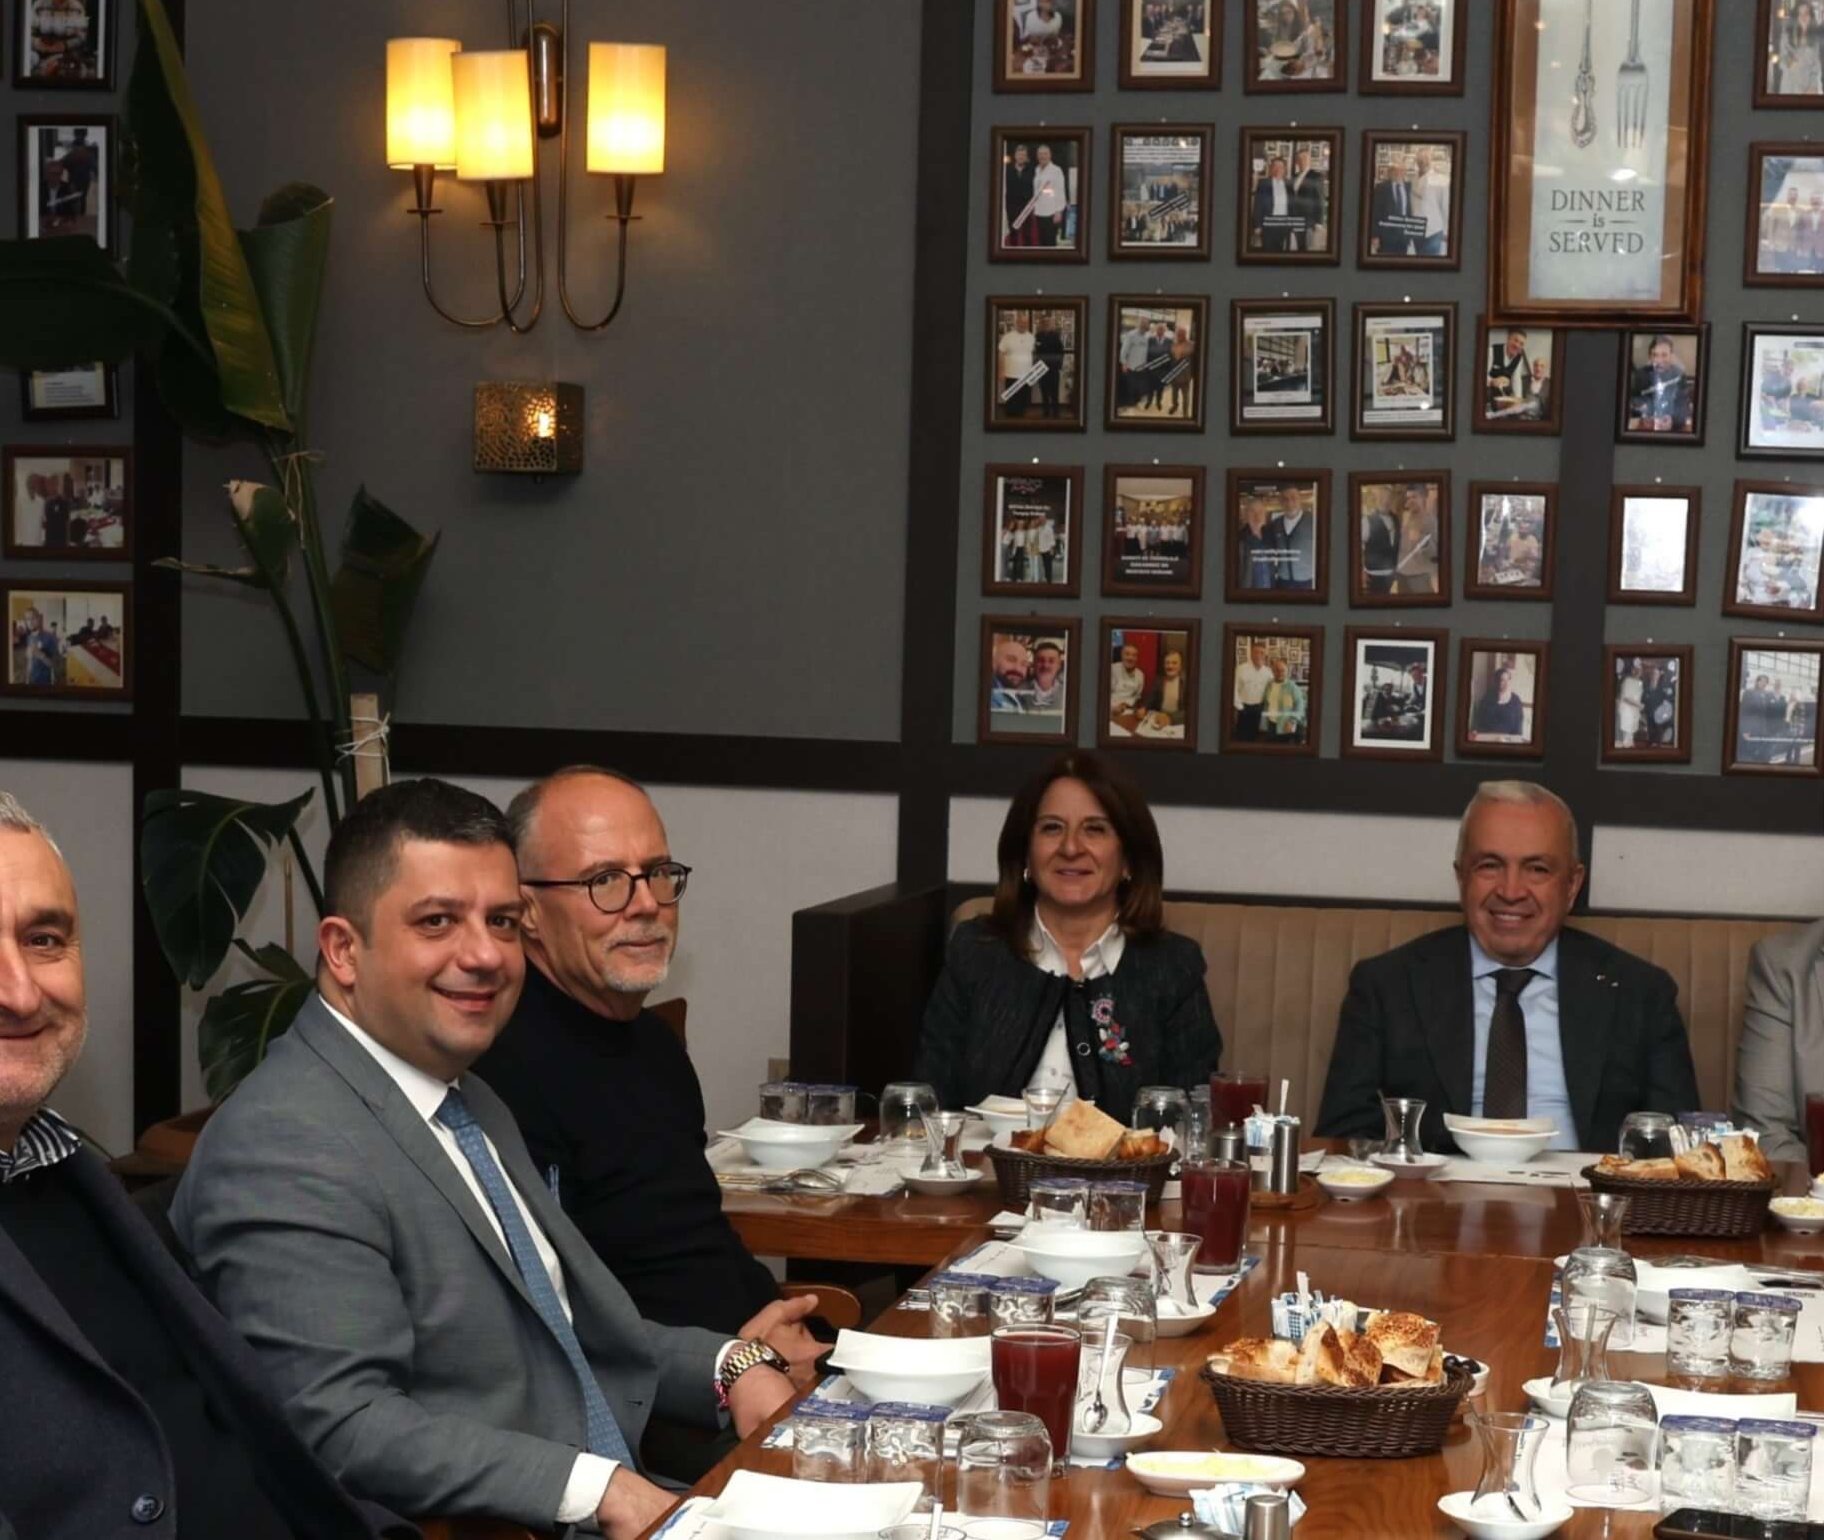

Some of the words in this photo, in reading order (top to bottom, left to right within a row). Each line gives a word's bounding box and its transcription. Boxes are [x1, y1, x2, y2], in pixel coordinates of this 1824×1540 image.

[1551, 189, 1645, 212] DINNER
[1592, 213, 1605, 228] is
[1548, 231, 1644, 254] SERVED
